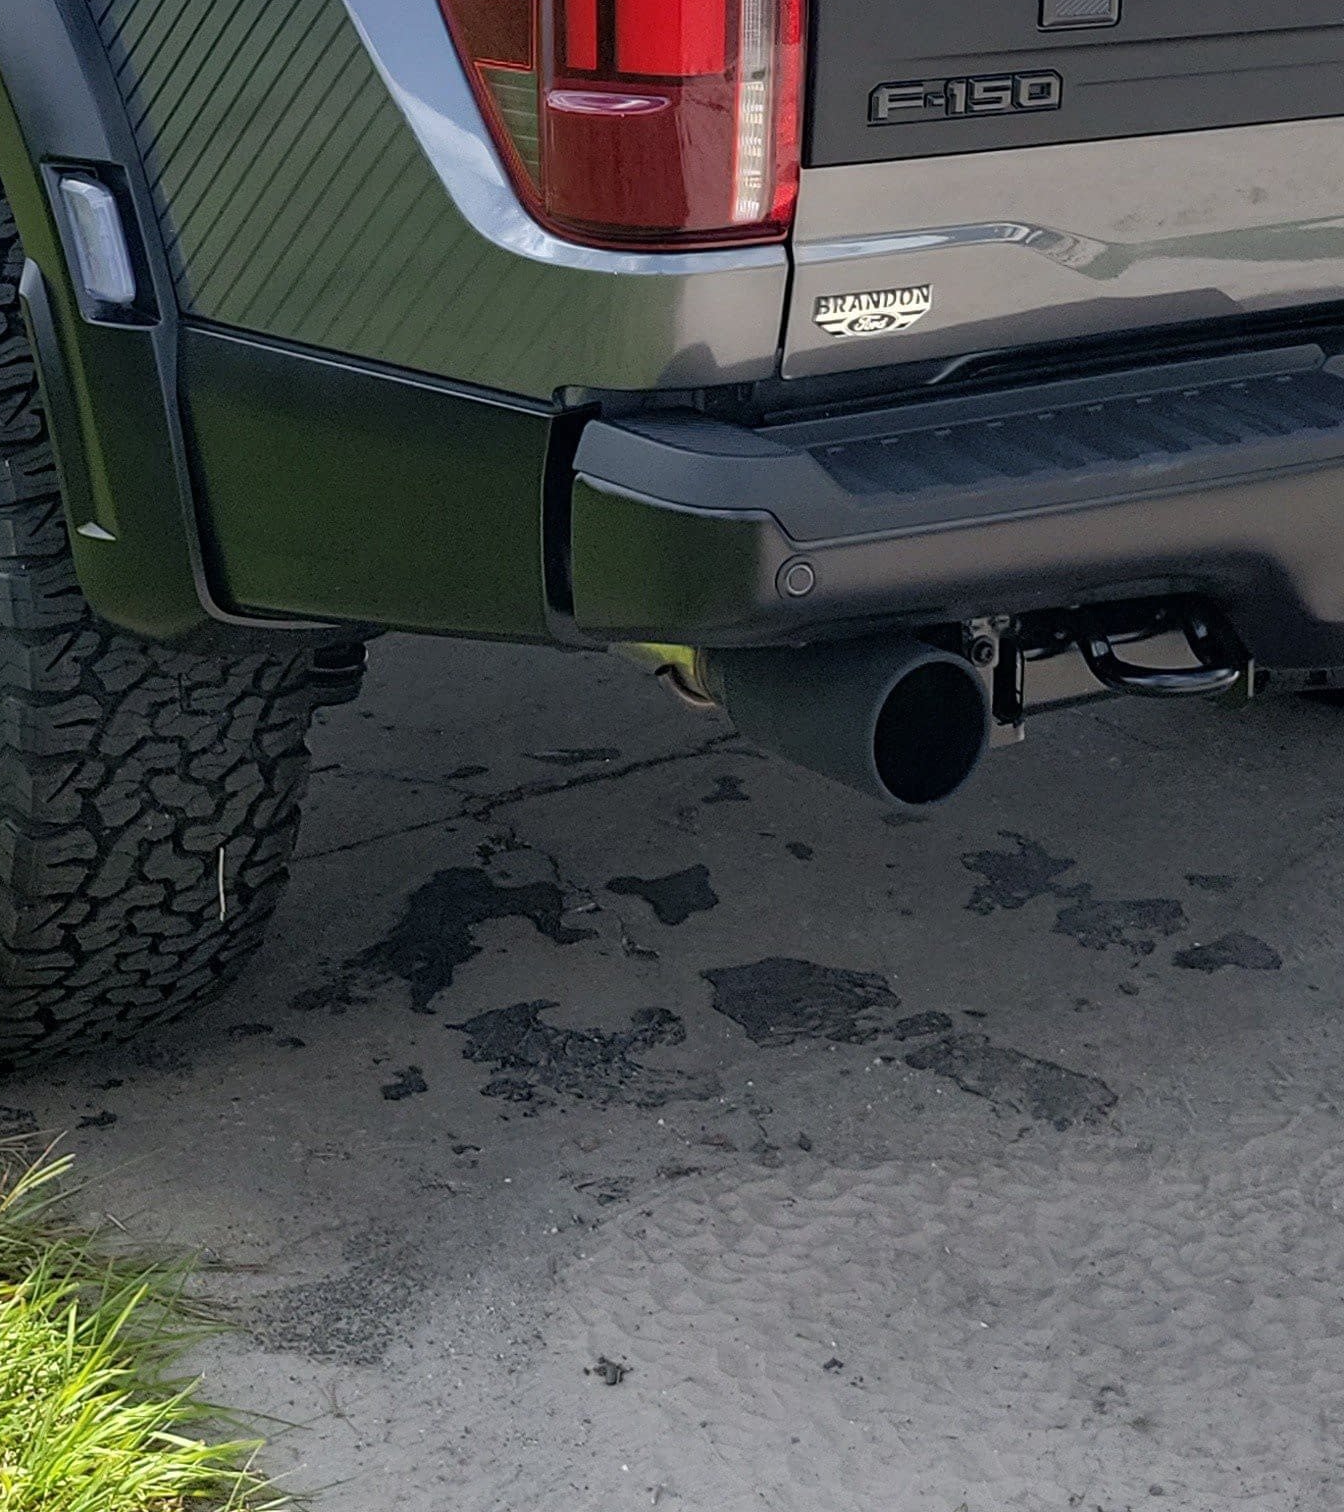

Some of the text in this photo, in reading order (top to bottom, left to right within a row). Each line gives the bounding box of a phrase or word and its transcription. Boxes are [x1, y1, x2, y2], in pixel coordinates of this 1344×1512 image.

[868, 69, 1063, 125] F-150
[815, 284, 932, 316] BRANDON
[854, 315, 890, 332] Ford
